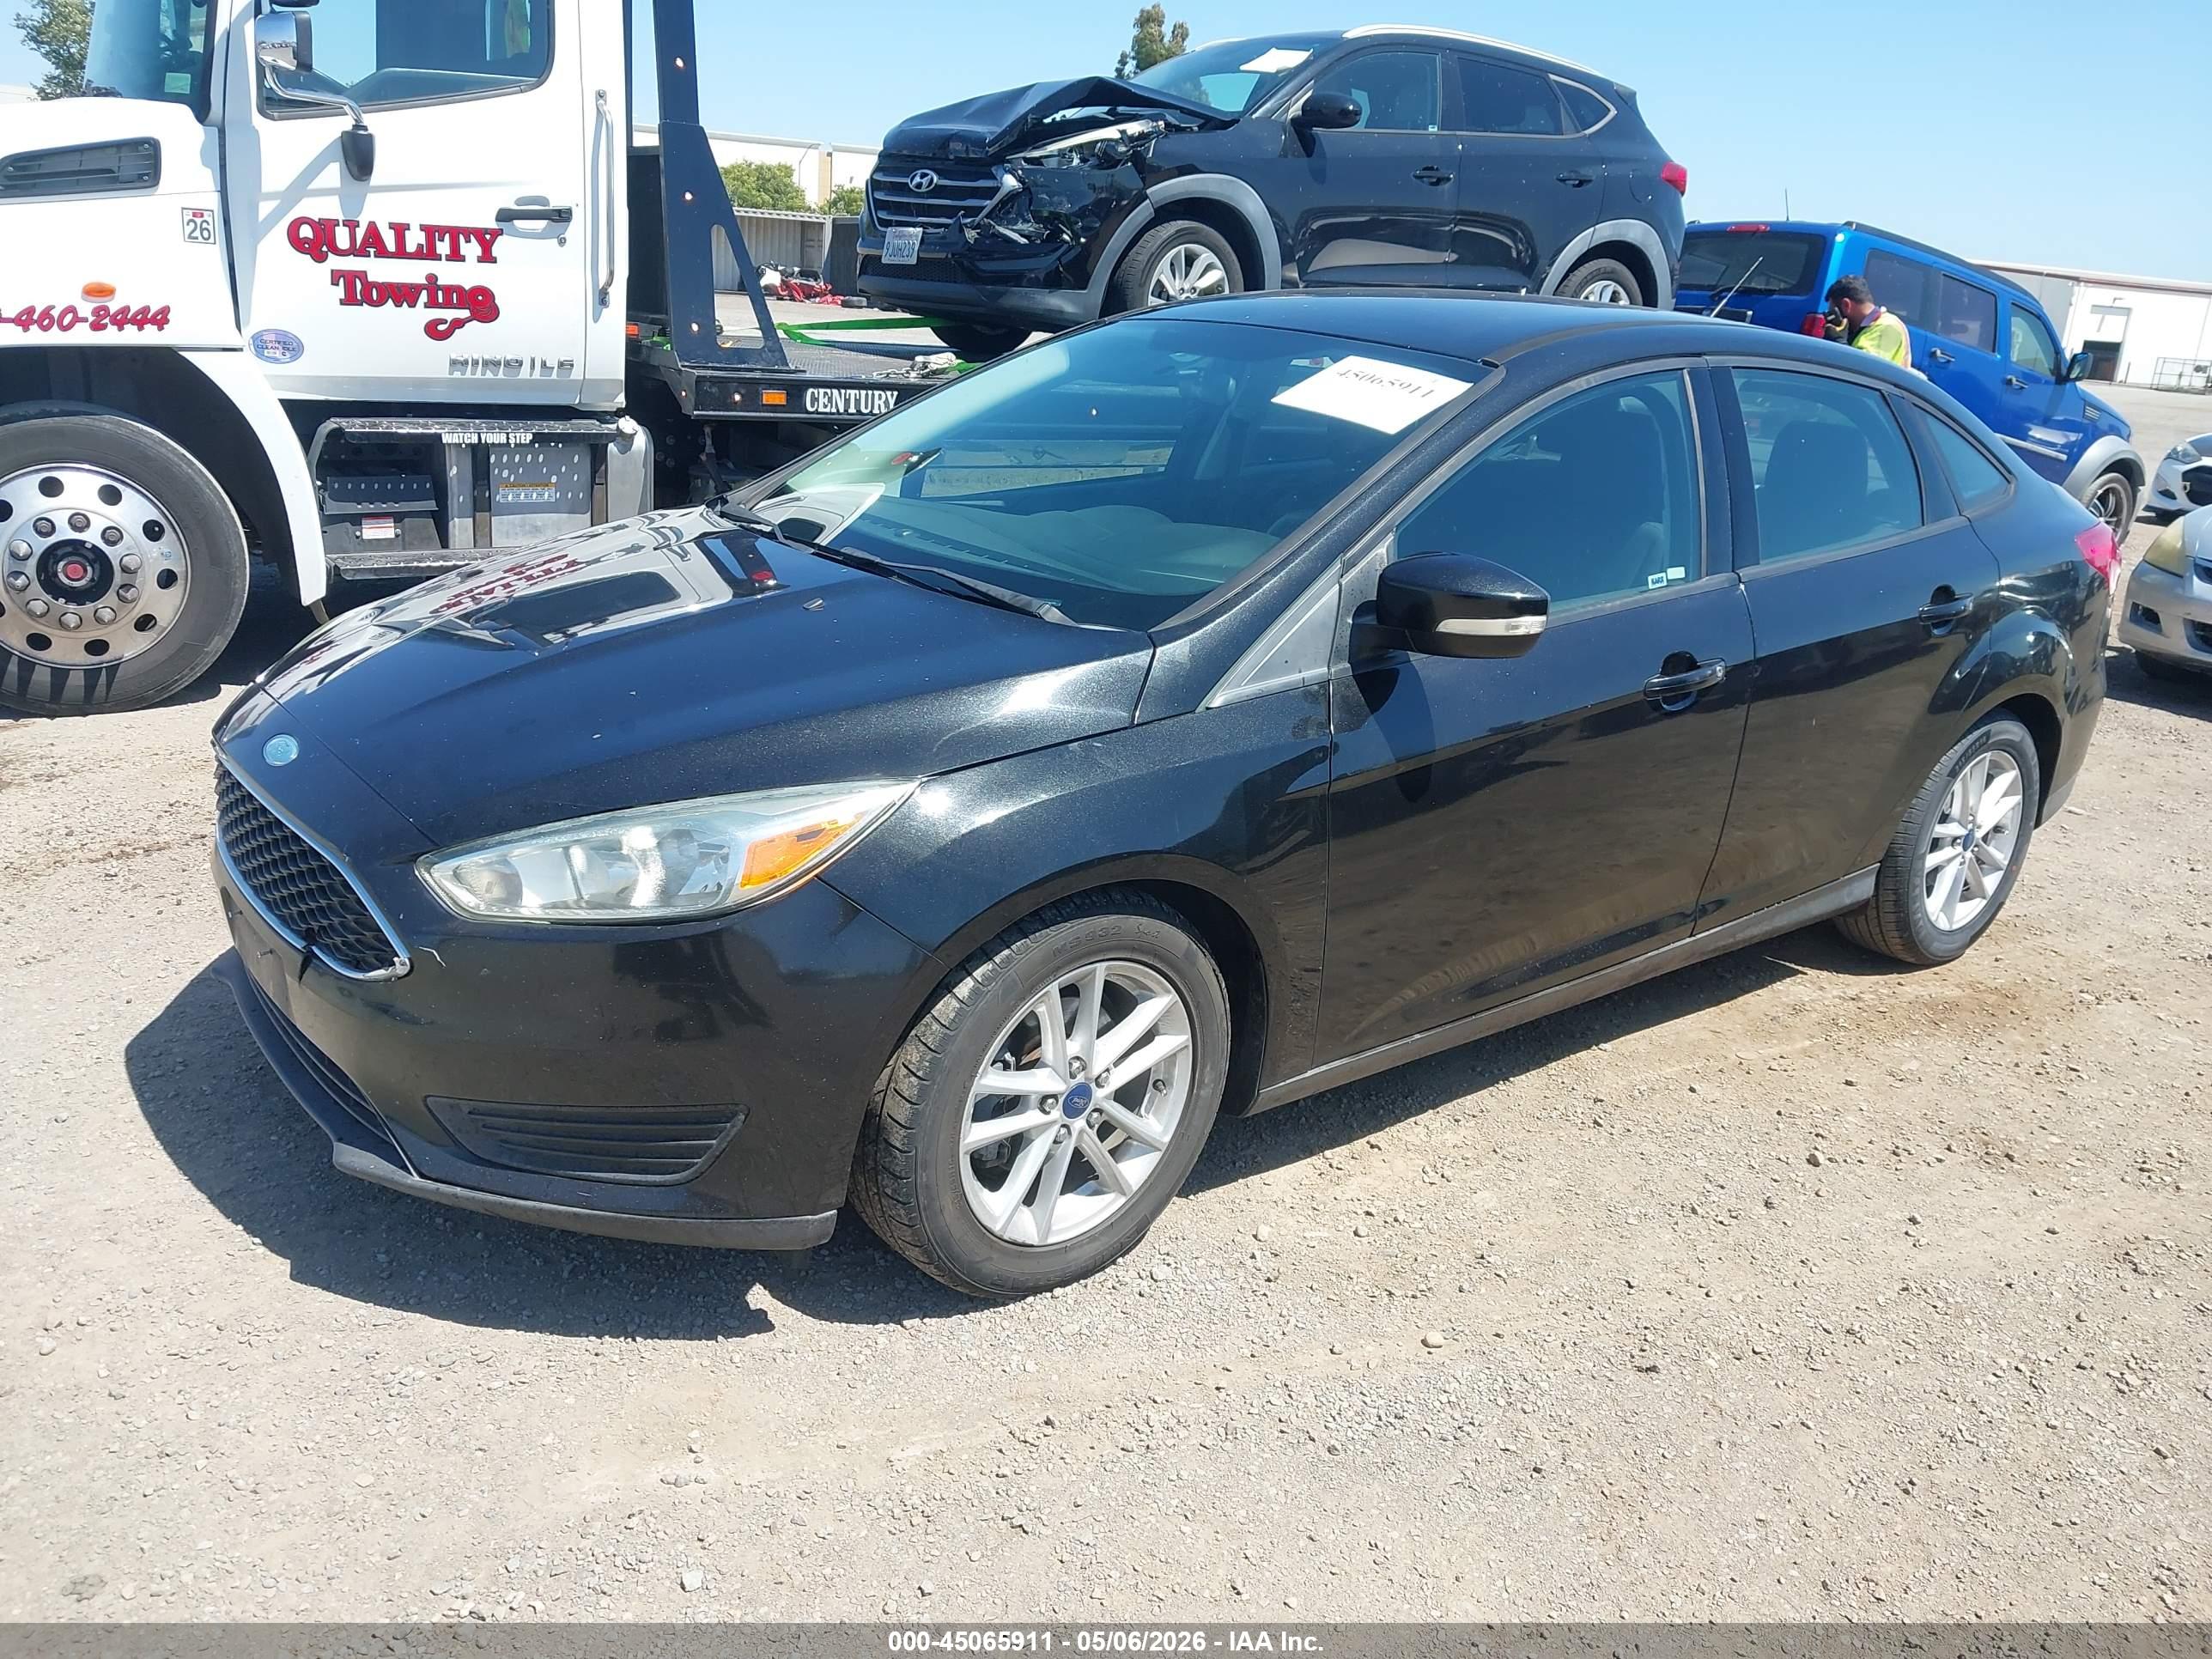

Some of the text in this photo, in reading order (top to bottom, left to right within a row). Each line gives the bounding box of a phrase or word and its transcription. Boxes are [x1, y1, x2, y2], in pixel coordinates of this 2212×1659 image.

[186, 218, 211, 241] 26
[287, 216, 504, 264] QUALITY
[0, 304, 171, 333] -460-2444
[331, 269, 500, 340] Towing
[805, 387, 899, 414] CENTURY
[441, 432, 533, 444] WATCH YOUR STEP
